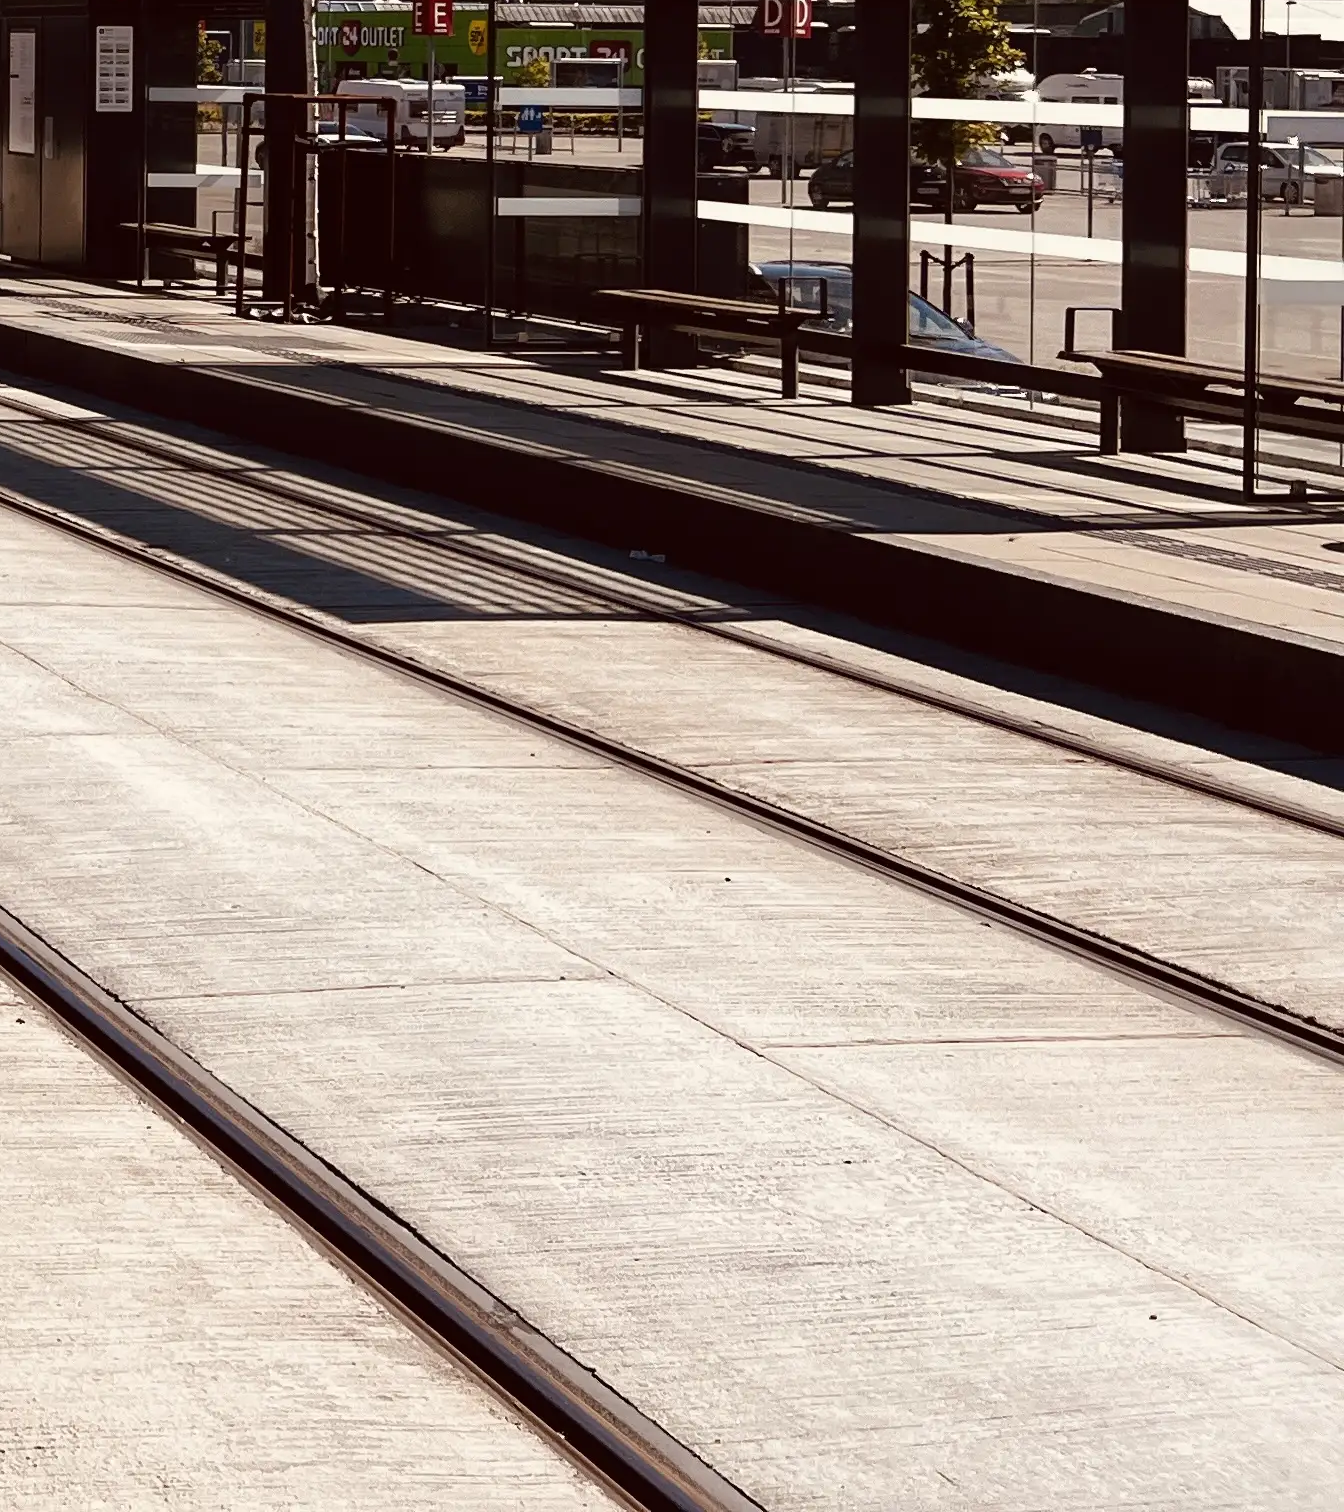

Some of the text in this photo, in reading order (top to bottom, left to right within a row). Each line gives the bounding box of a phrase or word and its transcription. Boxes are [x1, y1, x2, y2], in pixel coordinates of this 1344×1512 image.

[415, 2, 423, 27] E
[434, 2, 447, 27] E
[342, 26, 358, 46] 24
[362, 26, 404, 47] OUTLET
